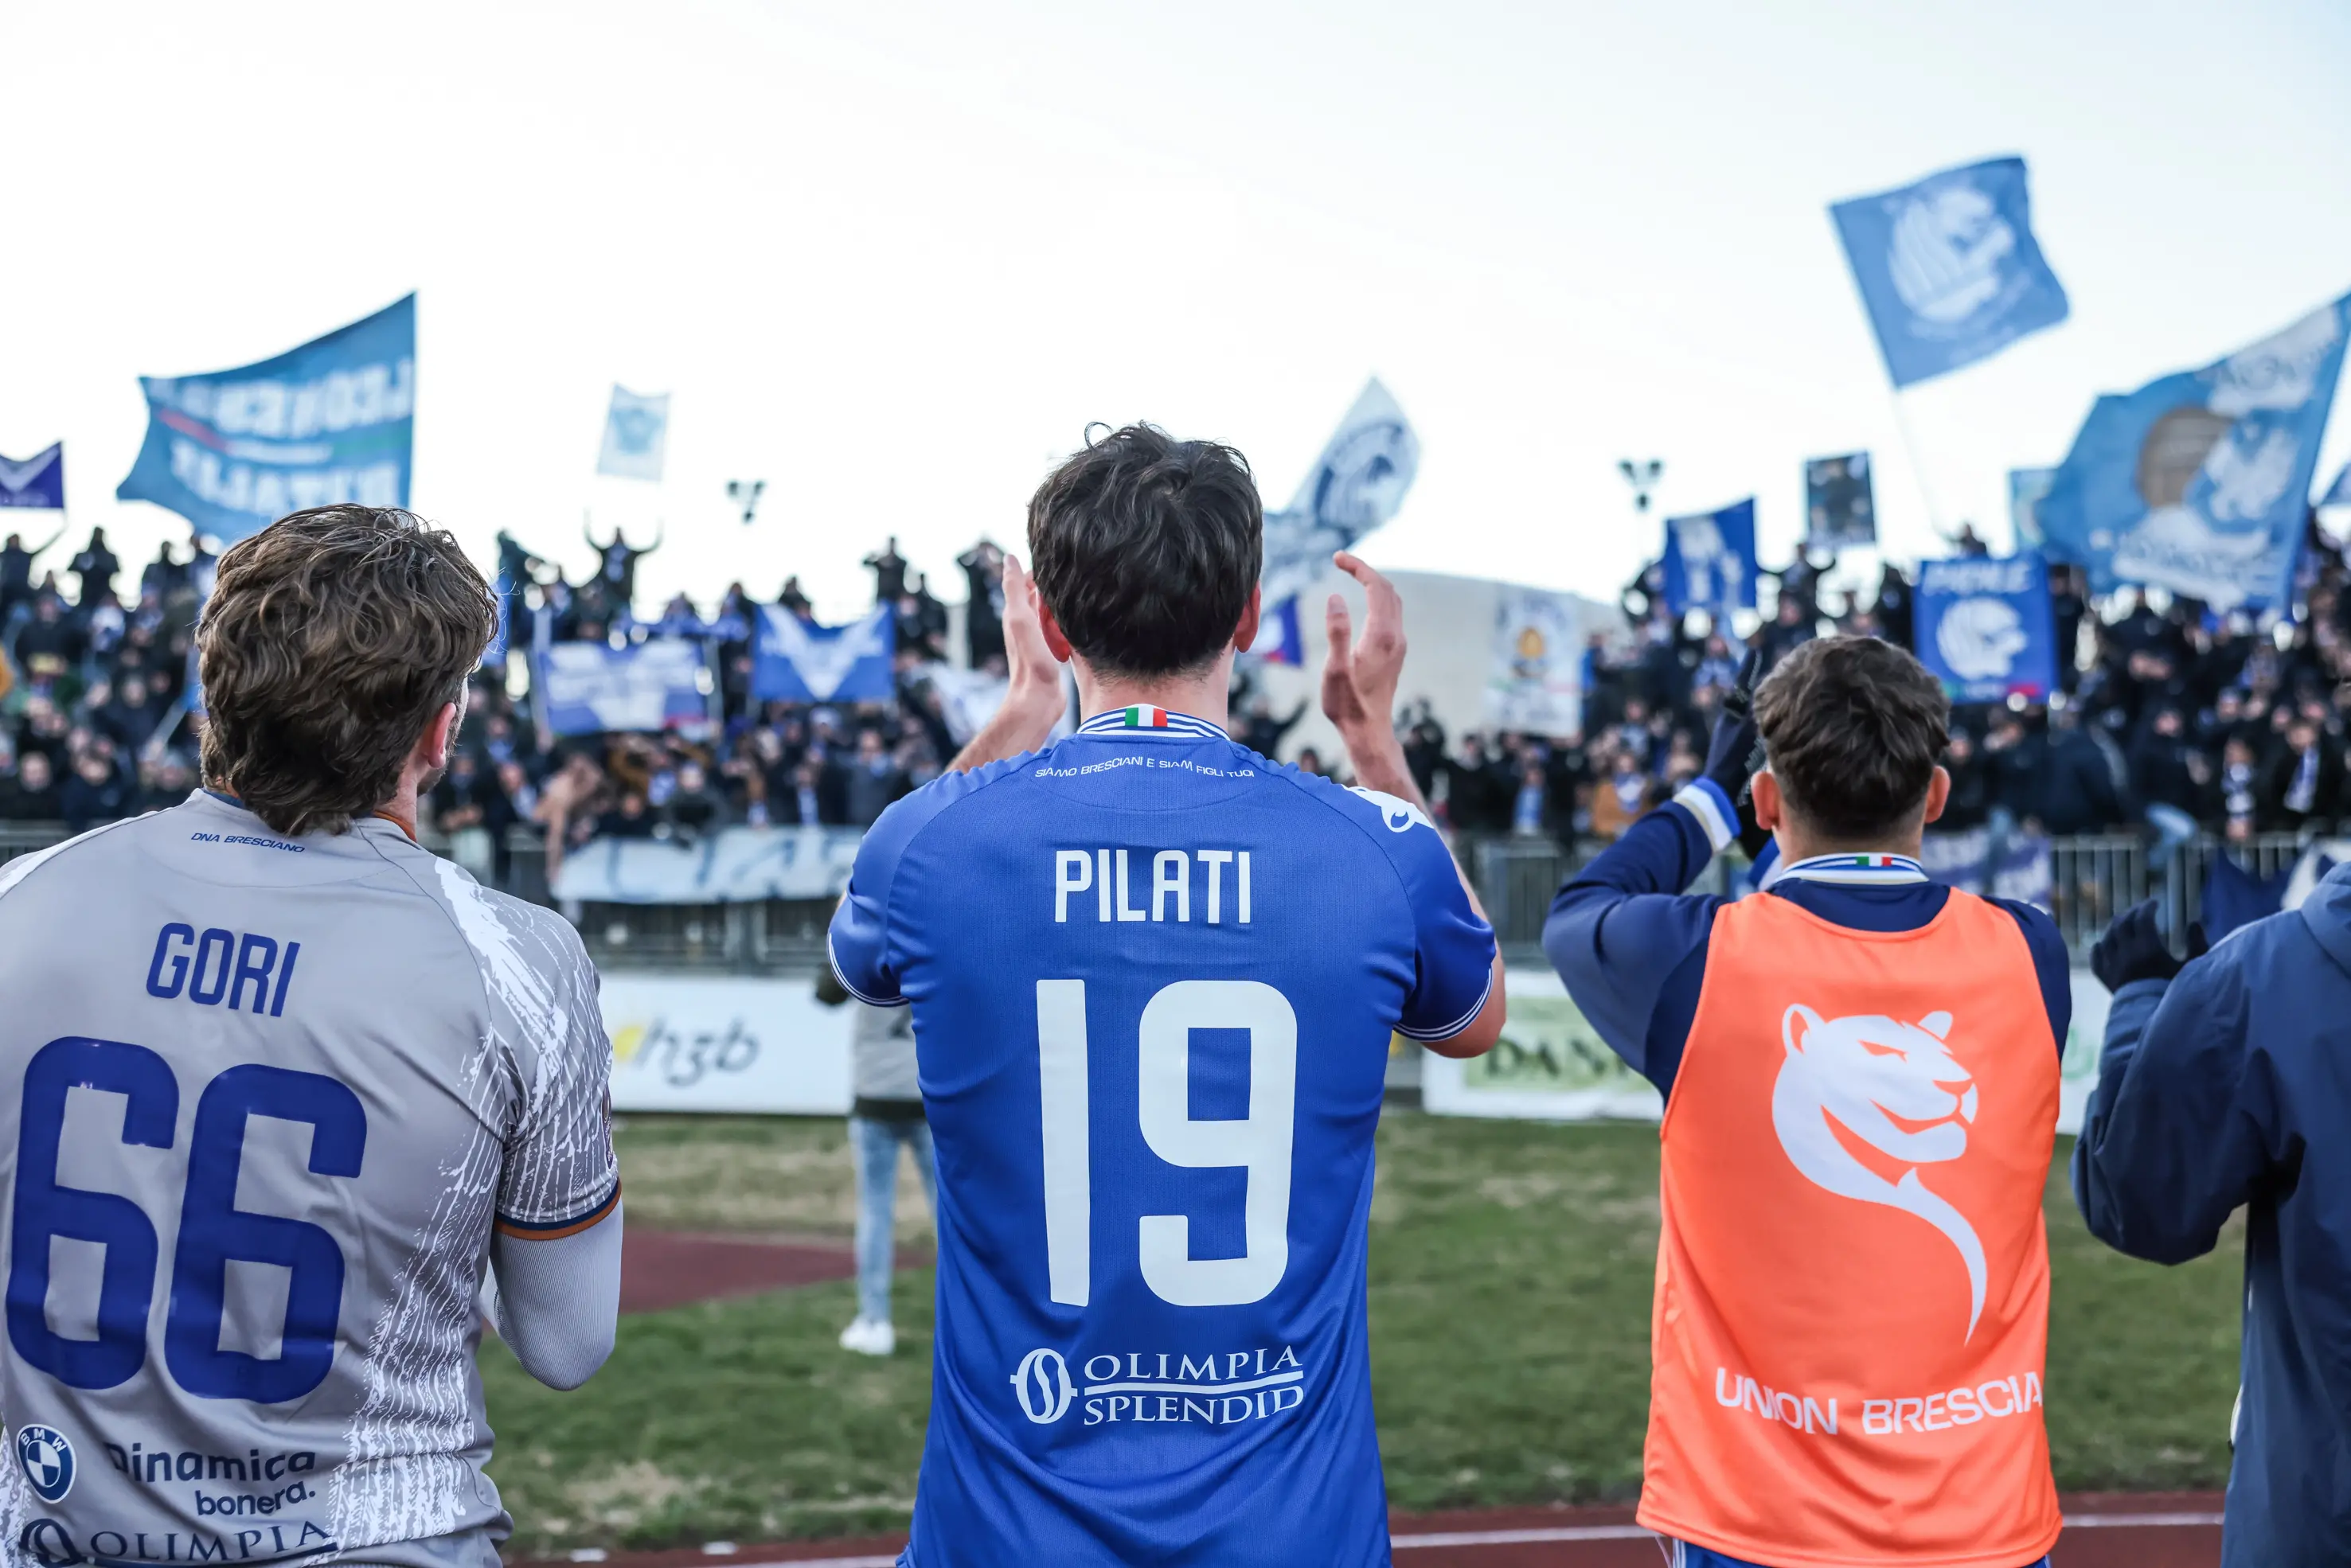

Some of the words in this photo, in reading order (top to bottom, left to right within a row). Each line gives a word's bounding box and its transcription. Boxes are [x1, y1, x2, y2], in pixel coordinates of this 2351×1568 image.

[1035, 767, 1077, 778] SIAMO
[1080, 756, 1143, 775] BRESCIANI
[1147, 758, 1155, 768] E
[1158, 759, 1193, 771] SIAM
[1196, 765, 1224, 777] FIGLI
[1226, 769, 1255, 778] TUOI
[191, 833, 220, 843] DNA
[224, 836, 306, 853] BRESCIANO
[1055, 849, 1250, 924] PILATI
[146, 922, 300, 1017] GORI
[1036, 978, 1298, 1307] 19
[6, 1036, 368, 1404] 66
[1084, 1344, 1303, 1381] OLIMPIA
[1084, 1385, 1305, 1426] SPLENDID
[1714, 1367, 1838, 1435] UNION
[1861, 1371, 2044, 1435] BRESCIA
[20, 1428, 67, 1452] BMW
[103, 1442, 316, 1483] Dinamica
[195, 1481, 317, 1516] bonera.
[90, 1520, 332, 1562] OLIMPIA
